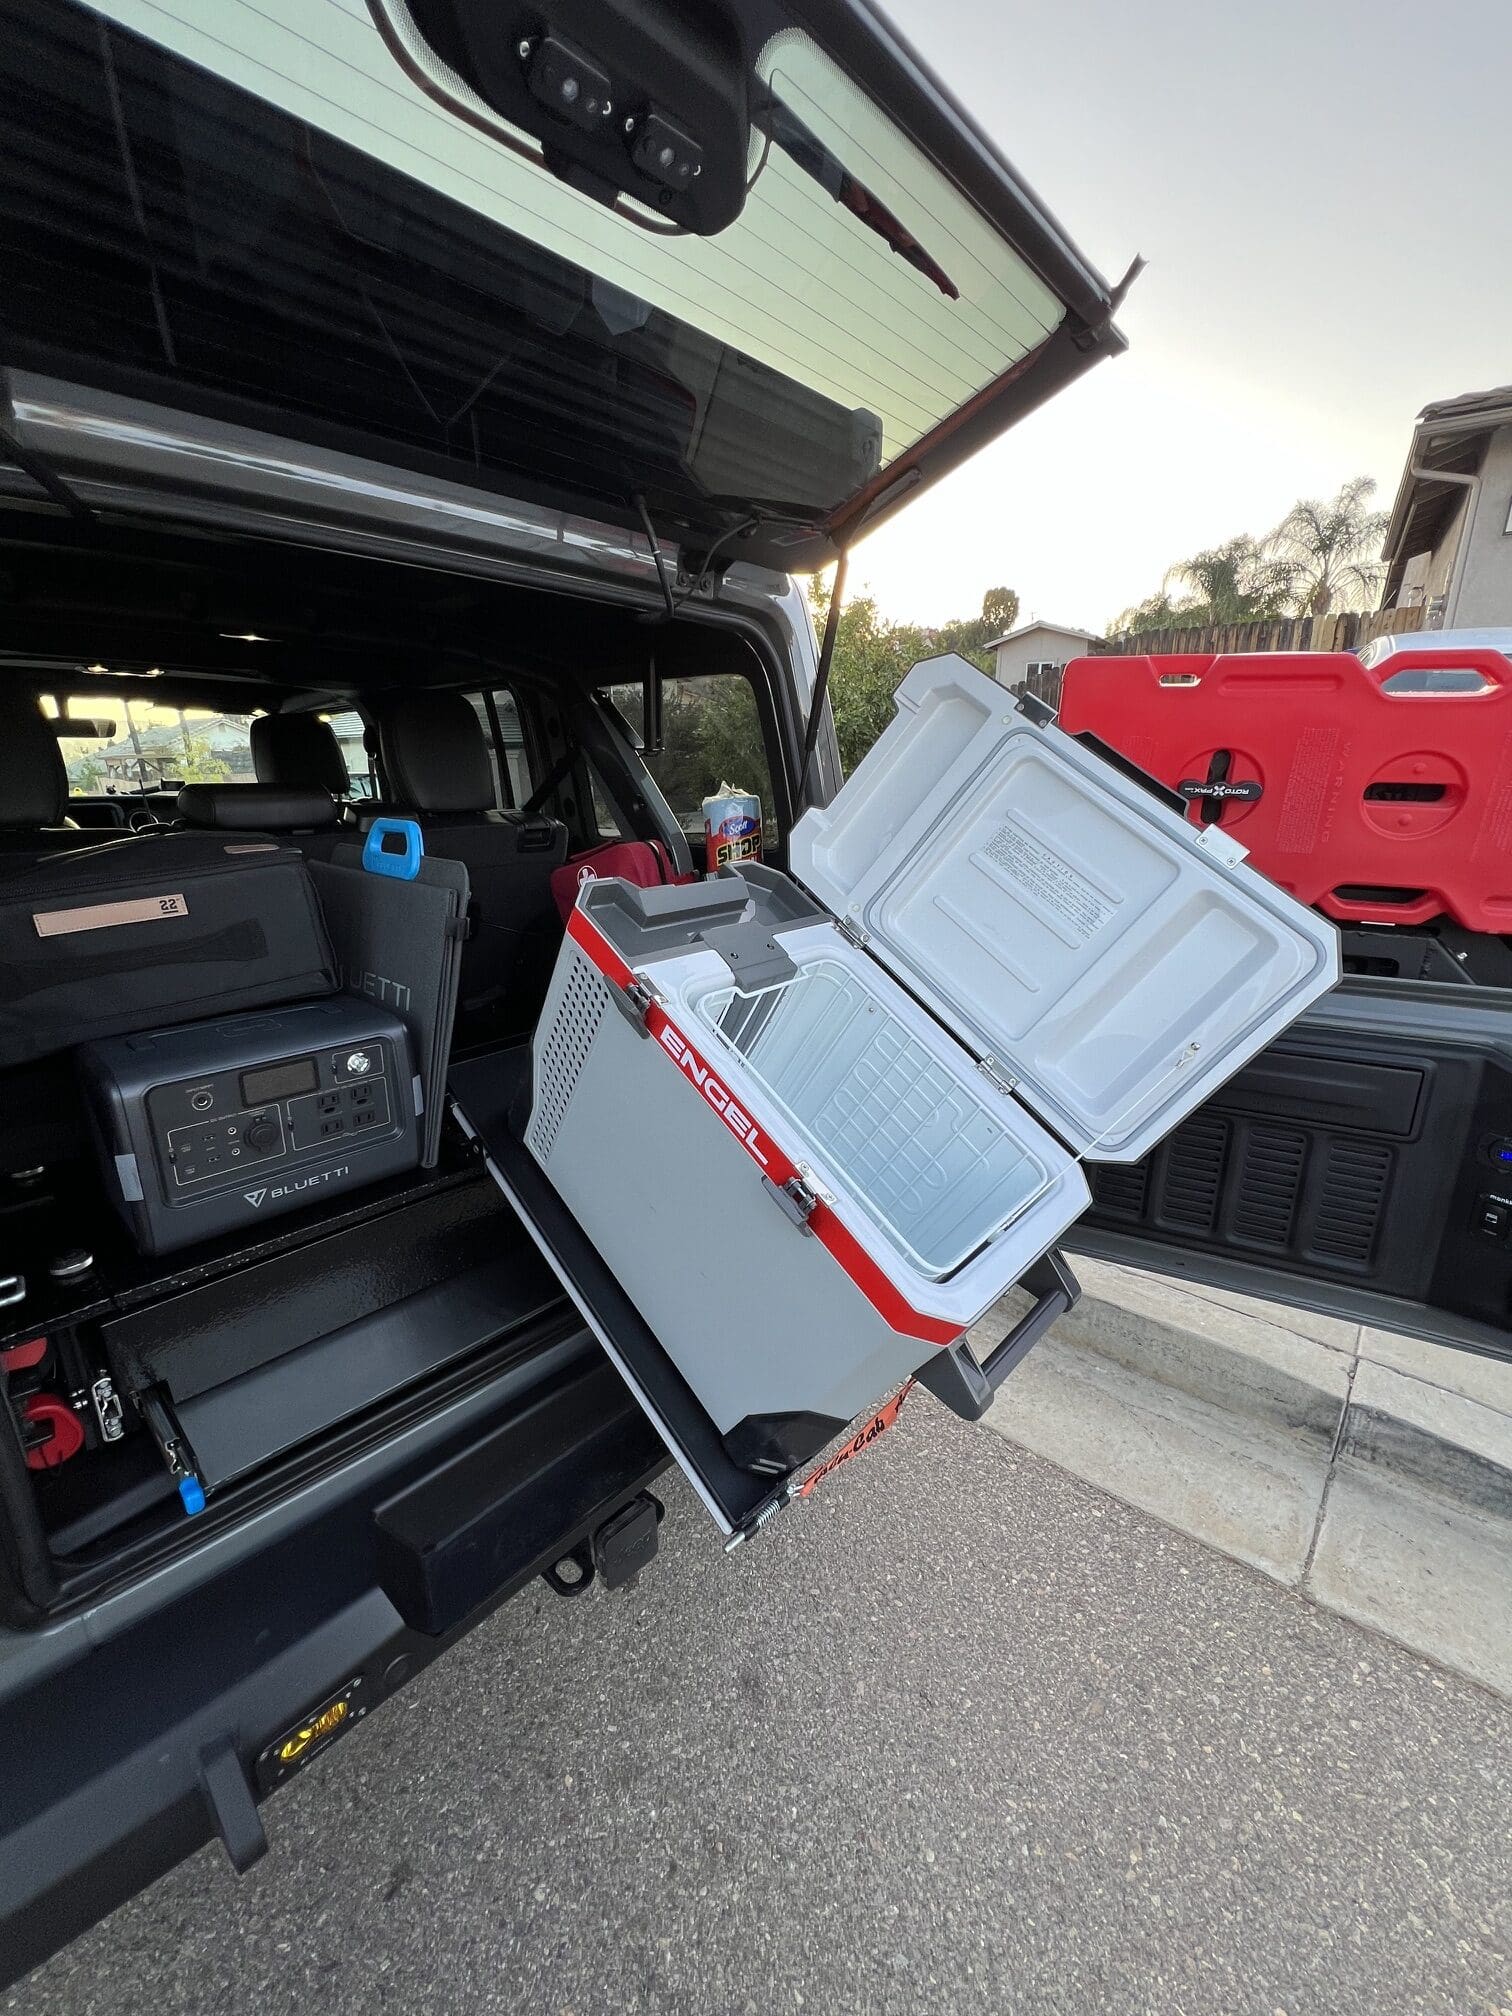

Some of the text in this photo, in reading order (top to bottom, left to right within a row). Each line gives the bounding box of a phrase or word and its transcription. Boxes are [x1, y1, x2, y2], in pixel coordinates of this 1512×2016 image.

[716, 833, 761, 867] SHOP
[159, 898, 178, 911] 22
[350, 969, 411, 1012] UETTI
[659, 1024, 769, 1166] ENGEL
[271, 1166, 349, 1199] BLUETTI
